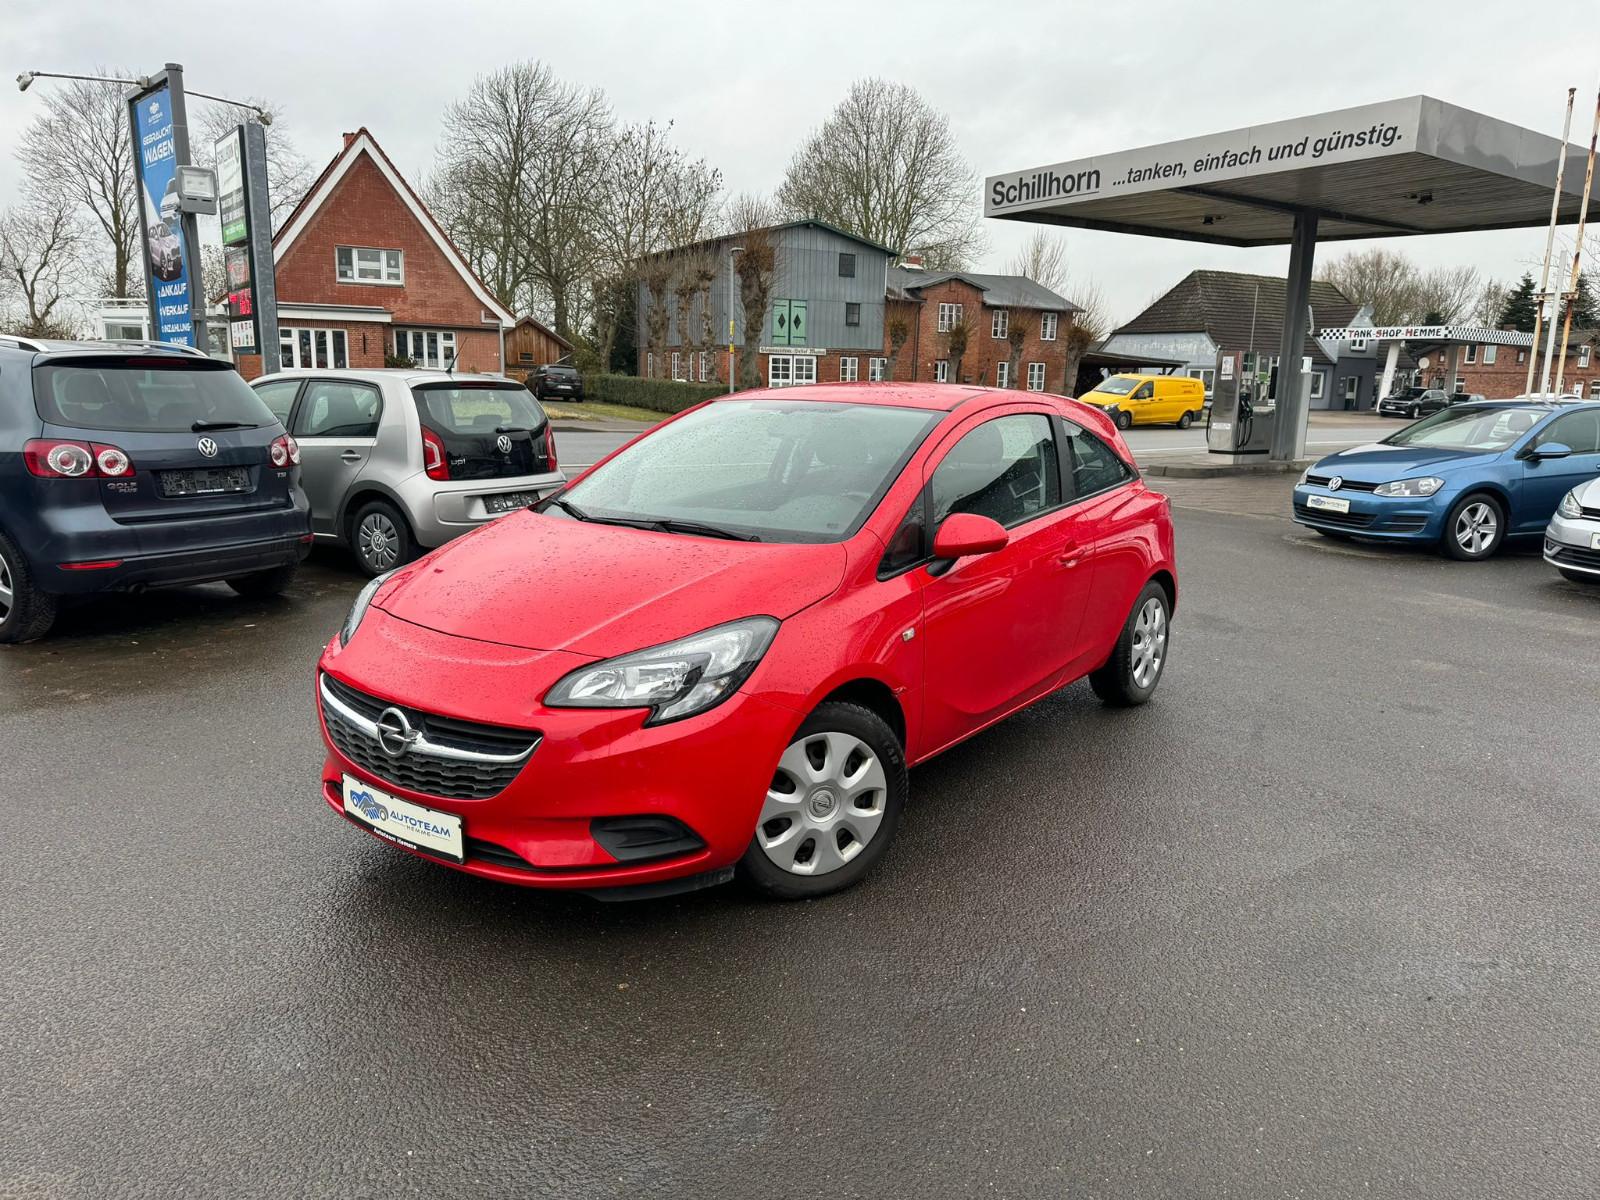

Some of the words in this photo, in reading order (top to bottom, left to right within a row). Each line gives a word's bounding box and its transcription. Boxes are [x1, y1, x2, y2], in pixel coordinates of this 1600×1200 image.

[143, 124, 172, 145] GEBRAUCHT
[144, 138, 174, 165] WAGEN
[992, 167, 1100, 206] Schillhorn
[1112, 160, 1187, 186] ...tanken,
[1193, 146, 1262, 173] einfach
[1267, 137, 1308, 161] und
[1312, 123, 1403, 158] günstig.
[160, 283, 187, 298] ANKAUF
[162, 304, 189, 316] VERKAUF
[390, 810, 451, 837] AUTOTEAM
[406, 825, 432, 837] HEMME
